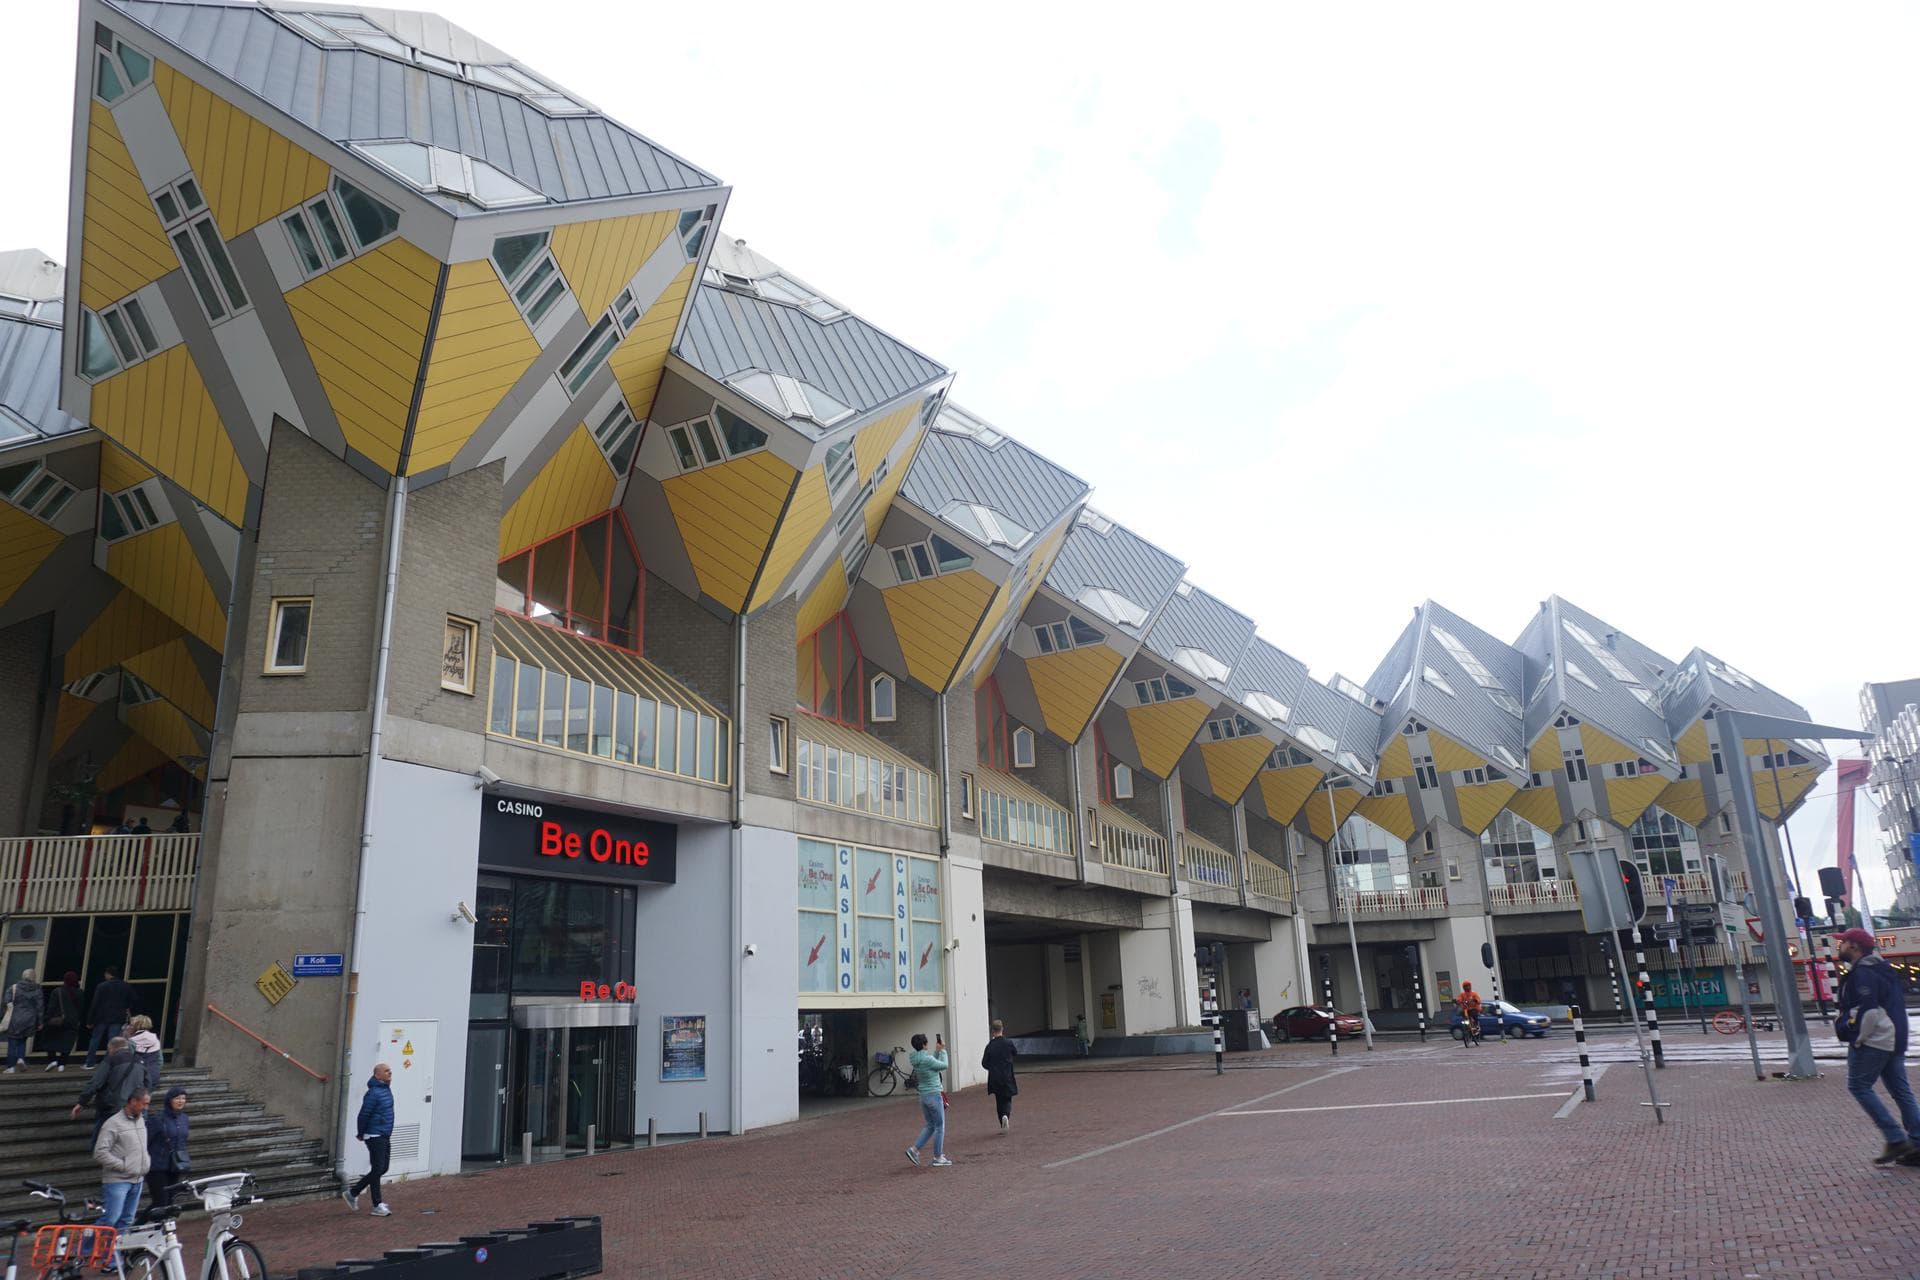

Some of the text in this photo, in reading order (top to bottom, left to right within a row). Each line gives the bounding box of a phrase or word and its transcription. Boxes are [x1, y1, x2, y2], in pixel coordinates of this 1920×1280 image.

[497, 799, 543, 818] CASINO
[541, 821, 649, 867] Be One
[808, 868, 833, 881] Be One
[839, 849, 851, 989] CASINO
[896, 859, 907, 990] CASINO
[580, 981, 611, 999] Be
[1671, 980, 1721, 996] HAVEN
